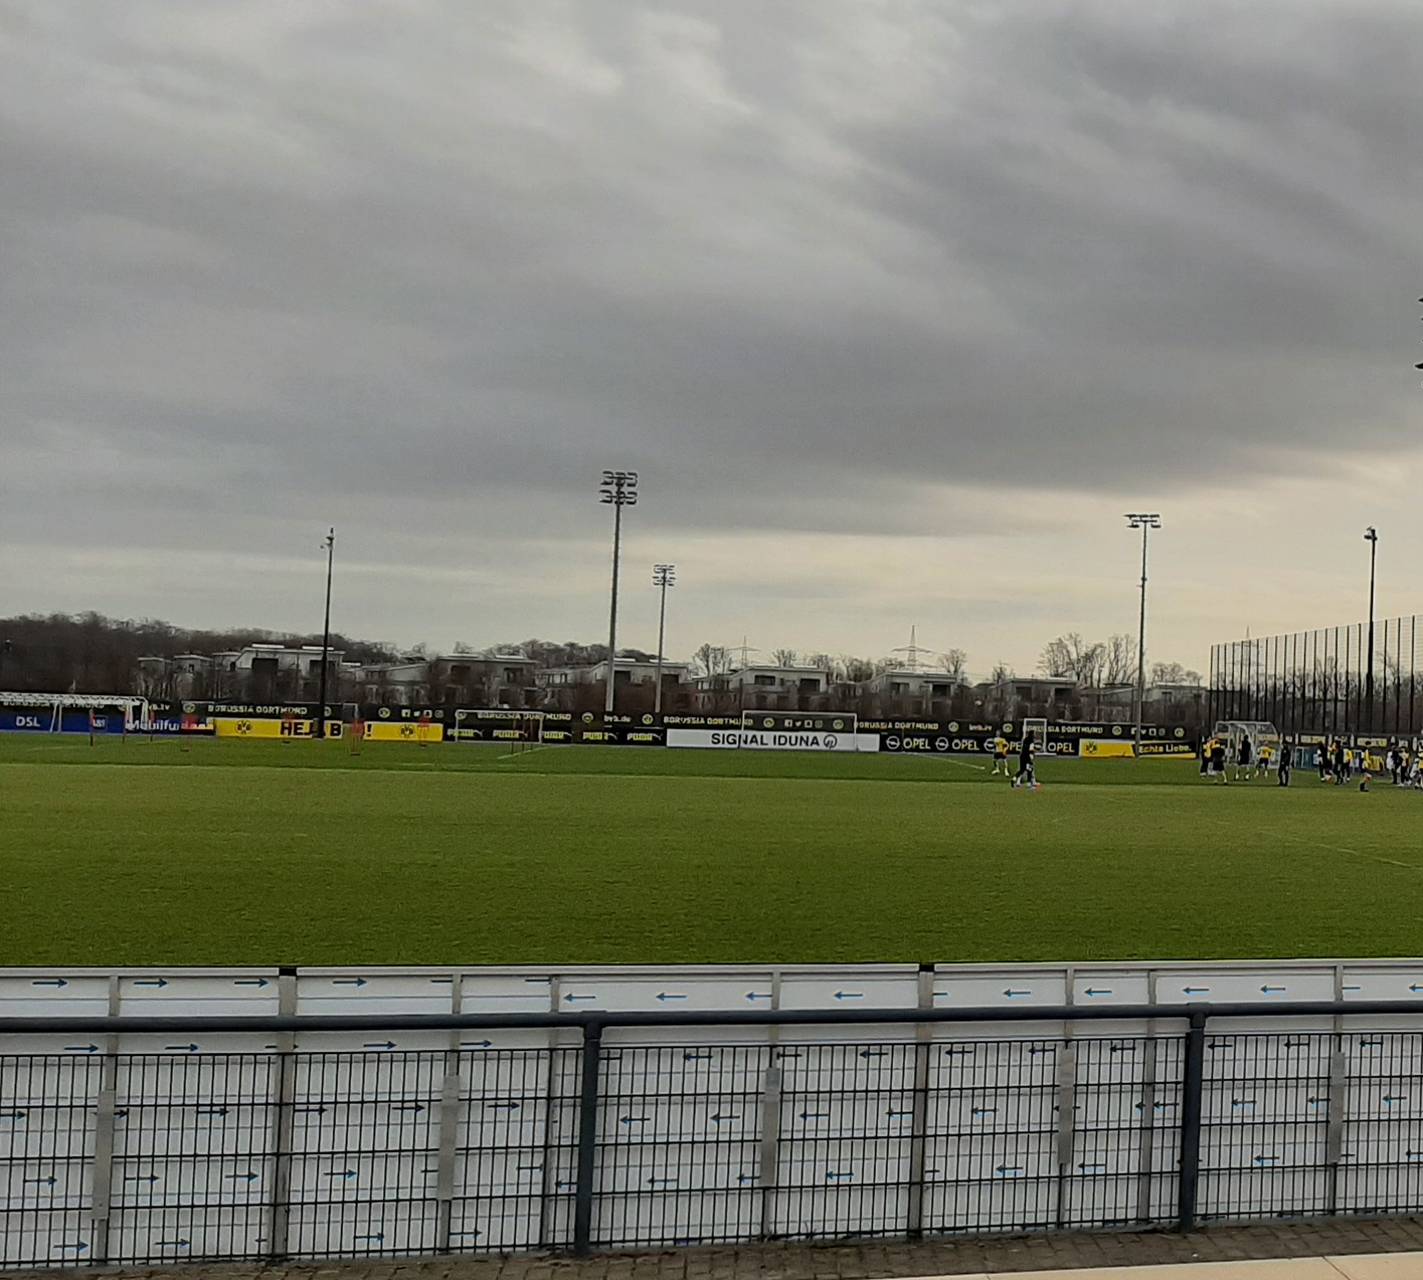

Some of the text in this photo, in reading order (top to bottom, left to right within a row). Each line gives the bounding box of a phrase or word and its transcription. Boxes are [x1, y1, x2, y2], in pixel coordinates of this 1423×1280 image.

[15, 716, 41, 727] DSL
[711, 733, 820, 748] SIGNAL IDUNA
[903, 738, 931, 749] OPEL
[952, 739, 980, 751] OPEL
[1048, 742, 1075, 753] OPEL
